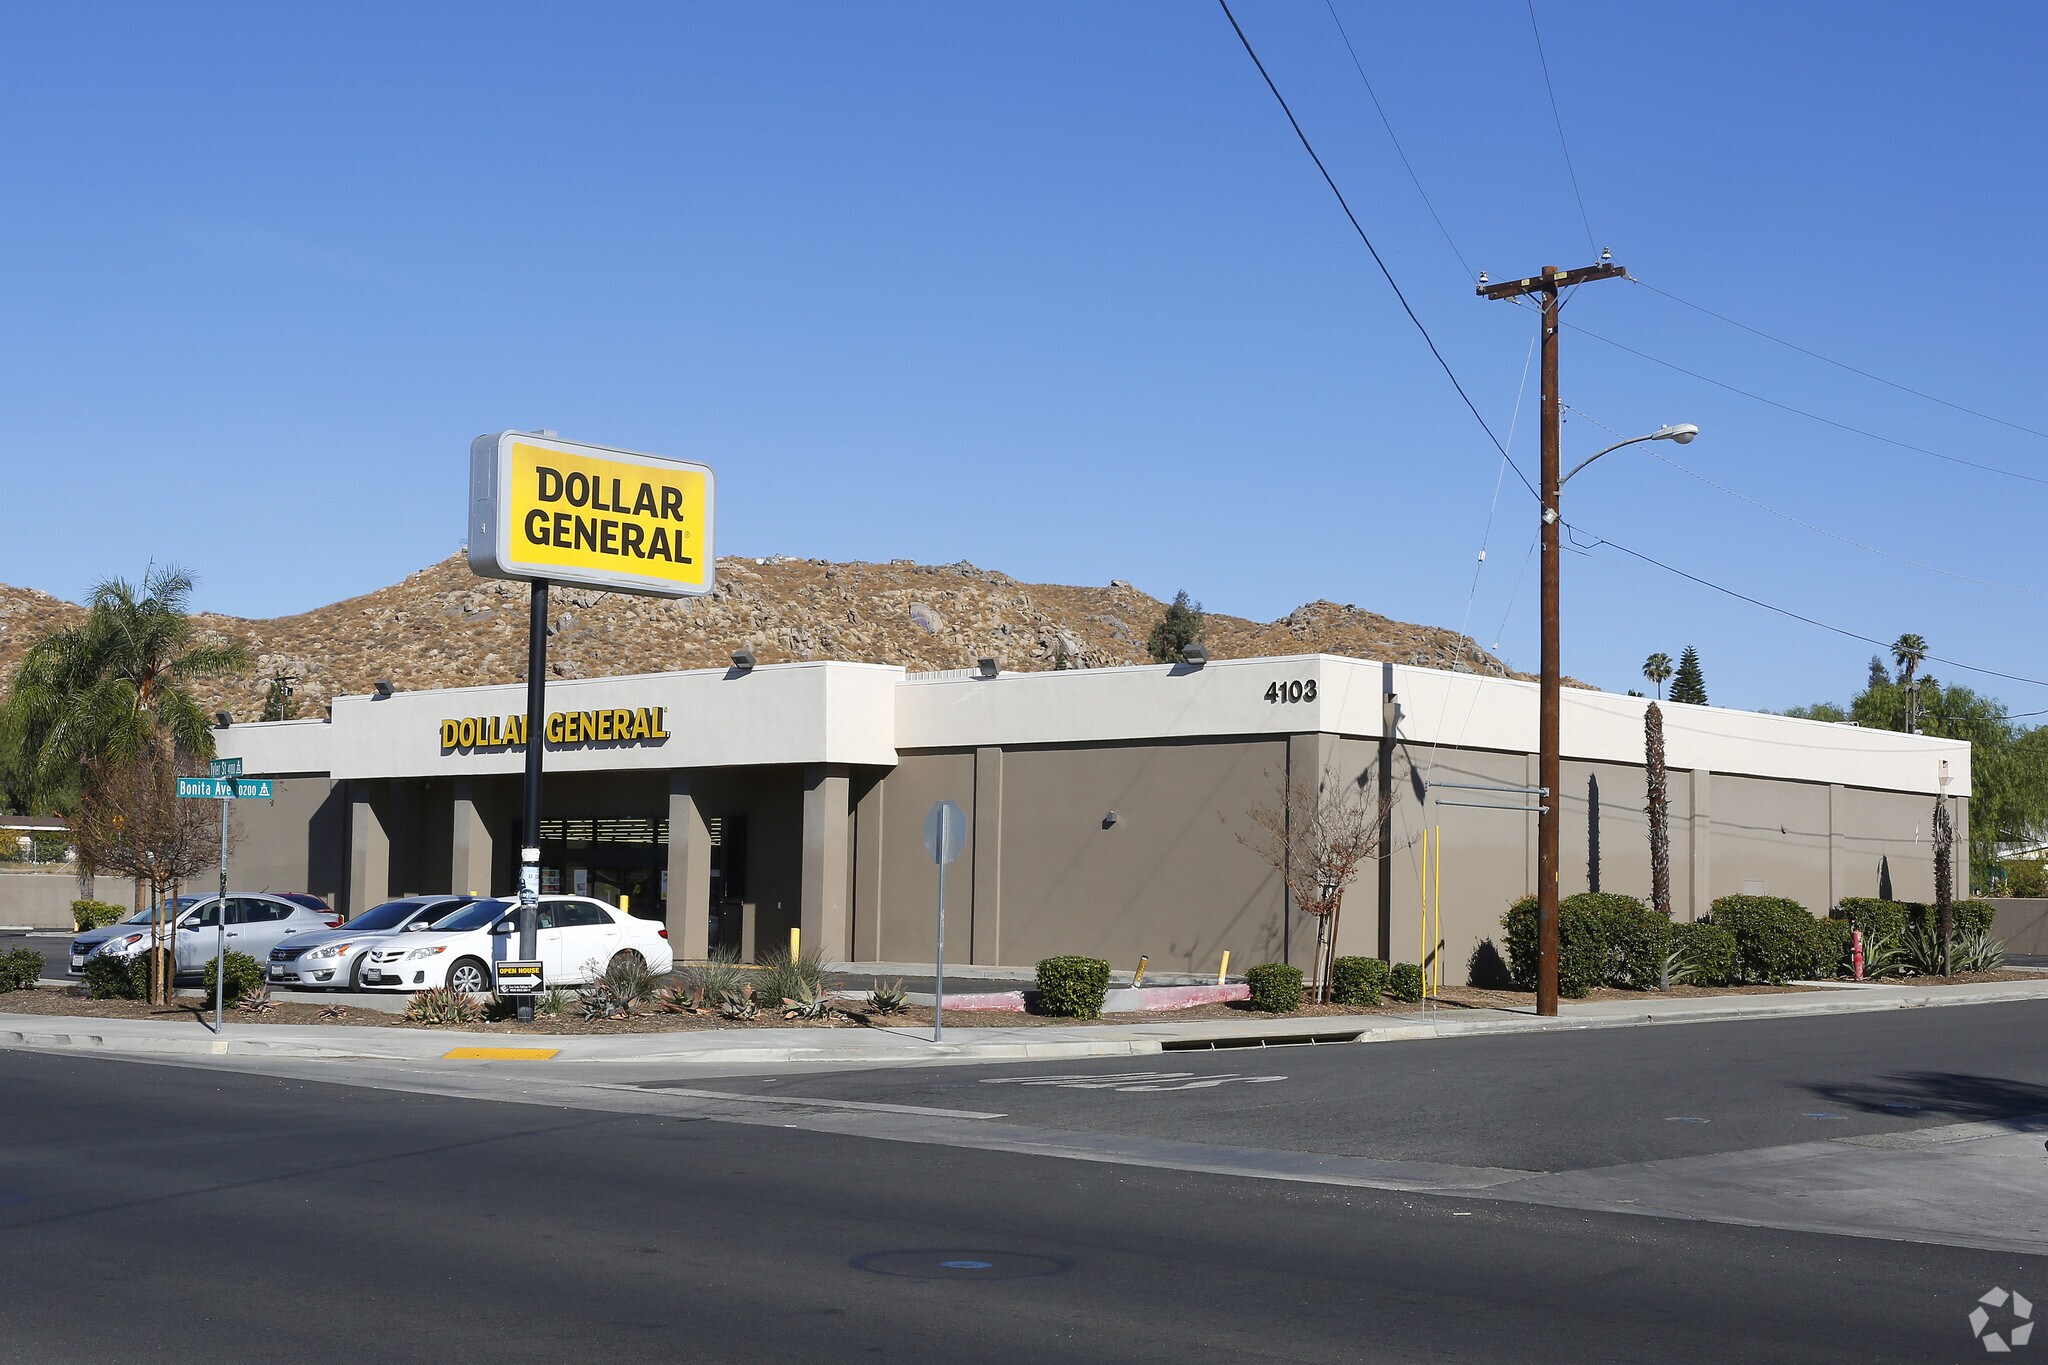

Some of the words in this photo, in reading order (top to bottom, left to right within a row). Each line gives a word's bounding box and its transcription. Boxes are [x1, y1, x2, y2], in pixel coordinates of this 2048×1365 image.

[536, 466, 684, 521] DOLLAR
[525, 508, 692, 564] GENERAL
[1264, 679, 1317, 704] 4103
[545, 707, 668, 745] GENERAL
[221, 761, 227, 775] St
[180, 781, 211, 795] Bonita
[215, 781, 231, 795] Ave
